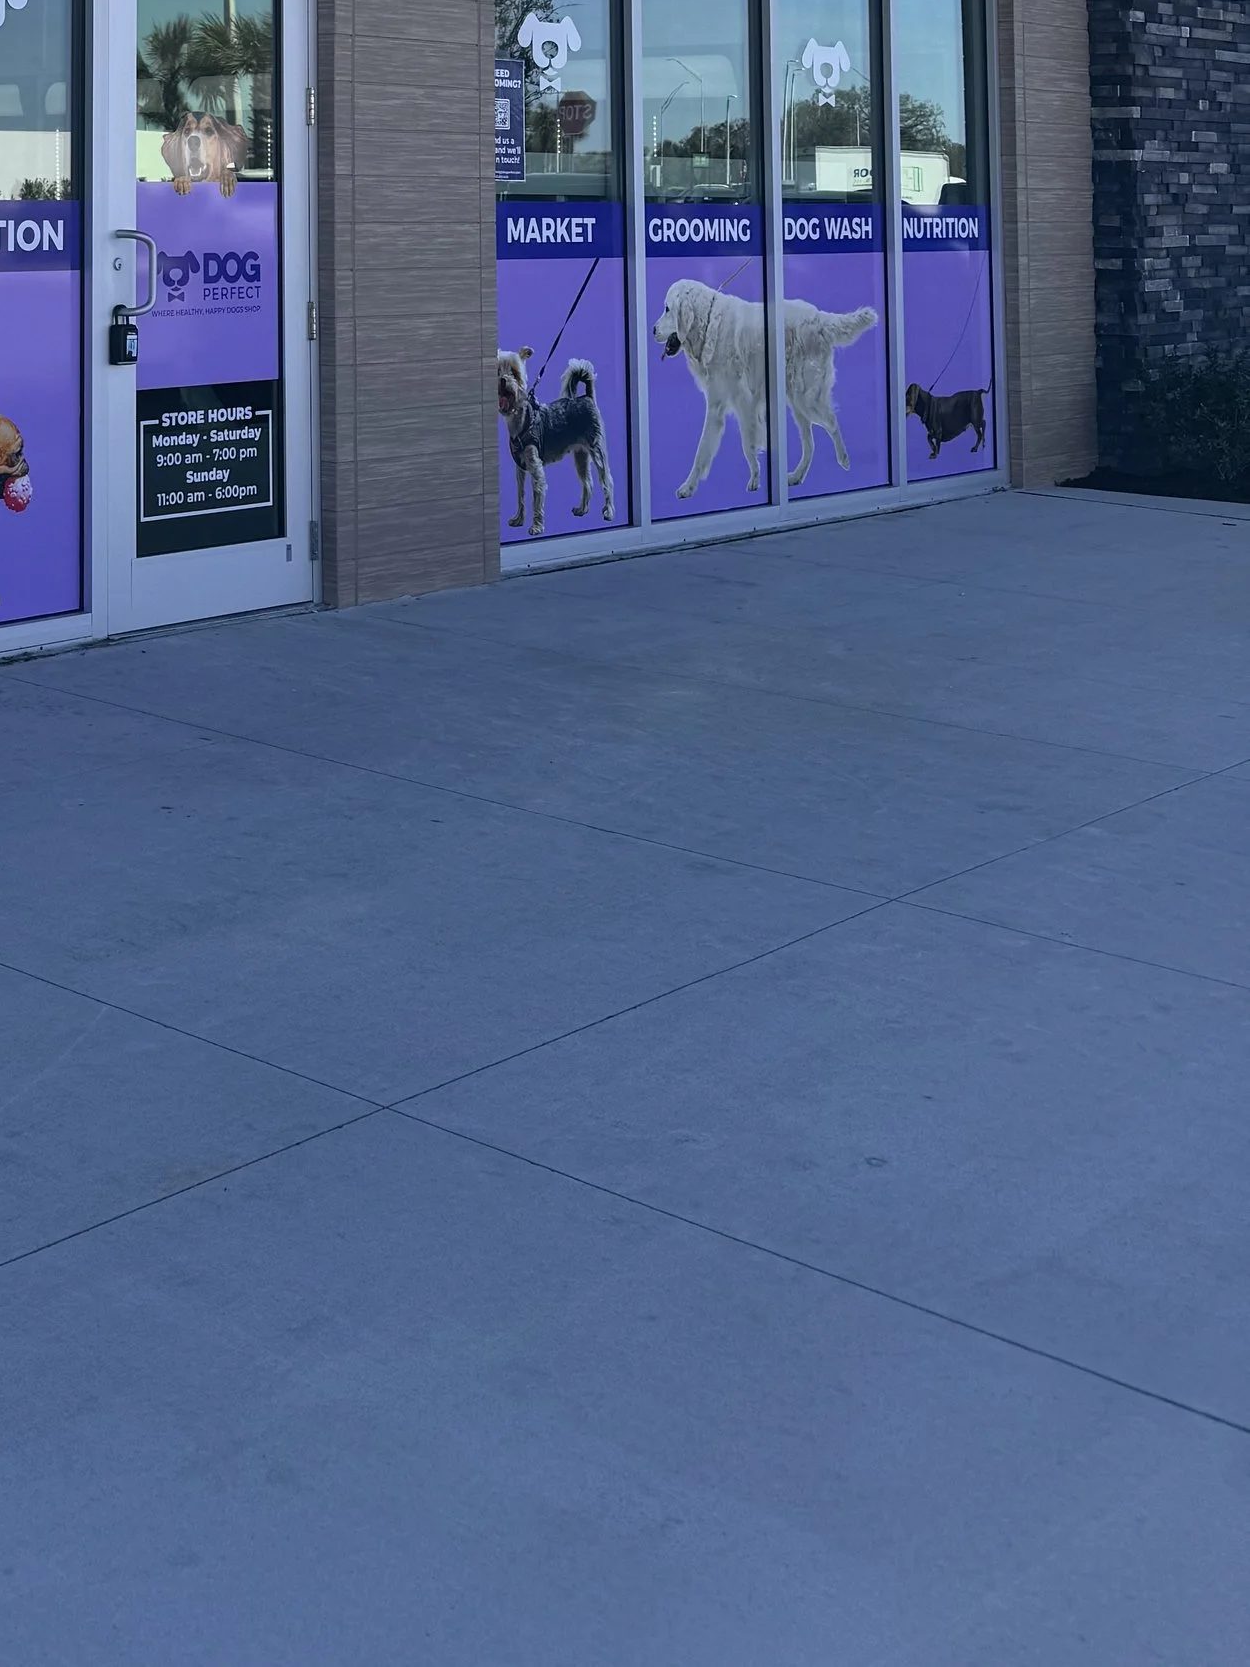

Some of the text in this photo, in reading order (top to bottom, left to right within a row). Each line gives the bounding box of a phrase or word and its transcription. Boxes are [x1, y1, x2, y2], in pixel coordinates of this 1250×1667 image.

[495, 69, 510, 77] EED
[495, 79, 522, 88] OMING?
[506, 217, 597, 243] MARKET
[648, 218, 751, 243] GROOMING
[783, 216, 873, 241] DOG WASH
[903, 217, 979, 239] NUTRITION
[203, 251, 261, 284] DOG
[203, 285, 262, 301] PERFECT
[151, 309, 175, 317] WHERE
[175, 308, 204, 317] HEALTHY,
[205, 306, 226, 315] HAPPY
[226, 305, 244, 314] DOGS
[161, 406, 253, 427] STORE HOURS
[152, 431, 201, 448] Monday
[209, 425, 262, 442] Saturday
[156, 452, 182, 467] 9:00
[184, 452, 203, 464] am
[212, 446, 237, 461] 7:00
[239, 446, 258, 461] pm
[186, 467, 230, 484] Sunday
[156, 491, 184, 507] 11:00
[186, 491, 205, 503] am
[215, 484, 257, 500] 6:00pm
